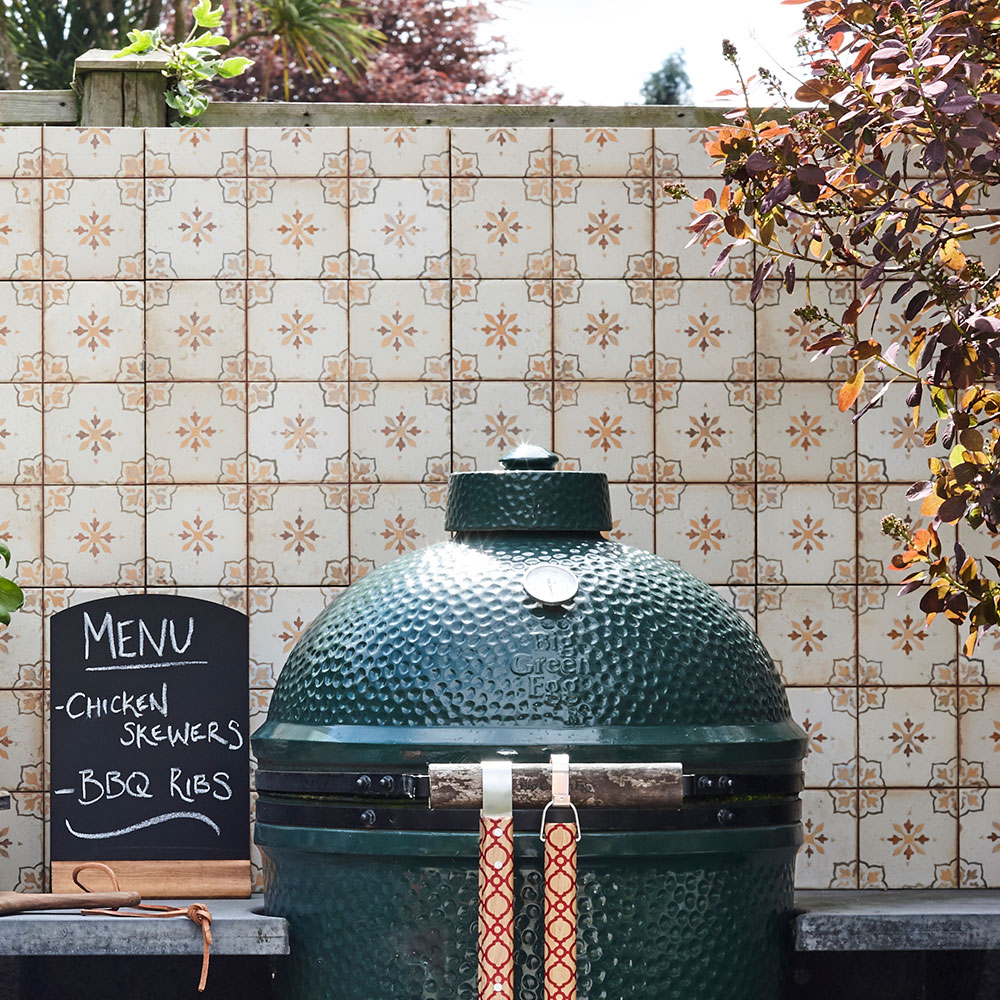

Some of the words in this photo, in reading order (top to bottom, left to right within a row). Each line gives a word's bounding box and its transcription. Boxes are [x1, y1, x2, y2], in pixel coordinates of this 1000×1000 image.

[83, 611, 194, 660] MENU
[532, 631, 575, 657] Big
[510, 652, 590, 676] Green
[528, 675, 579, 706] Egg
[120, 719, 244, 750] SKEWERS
[170, 766, 233, 804] RIBS
